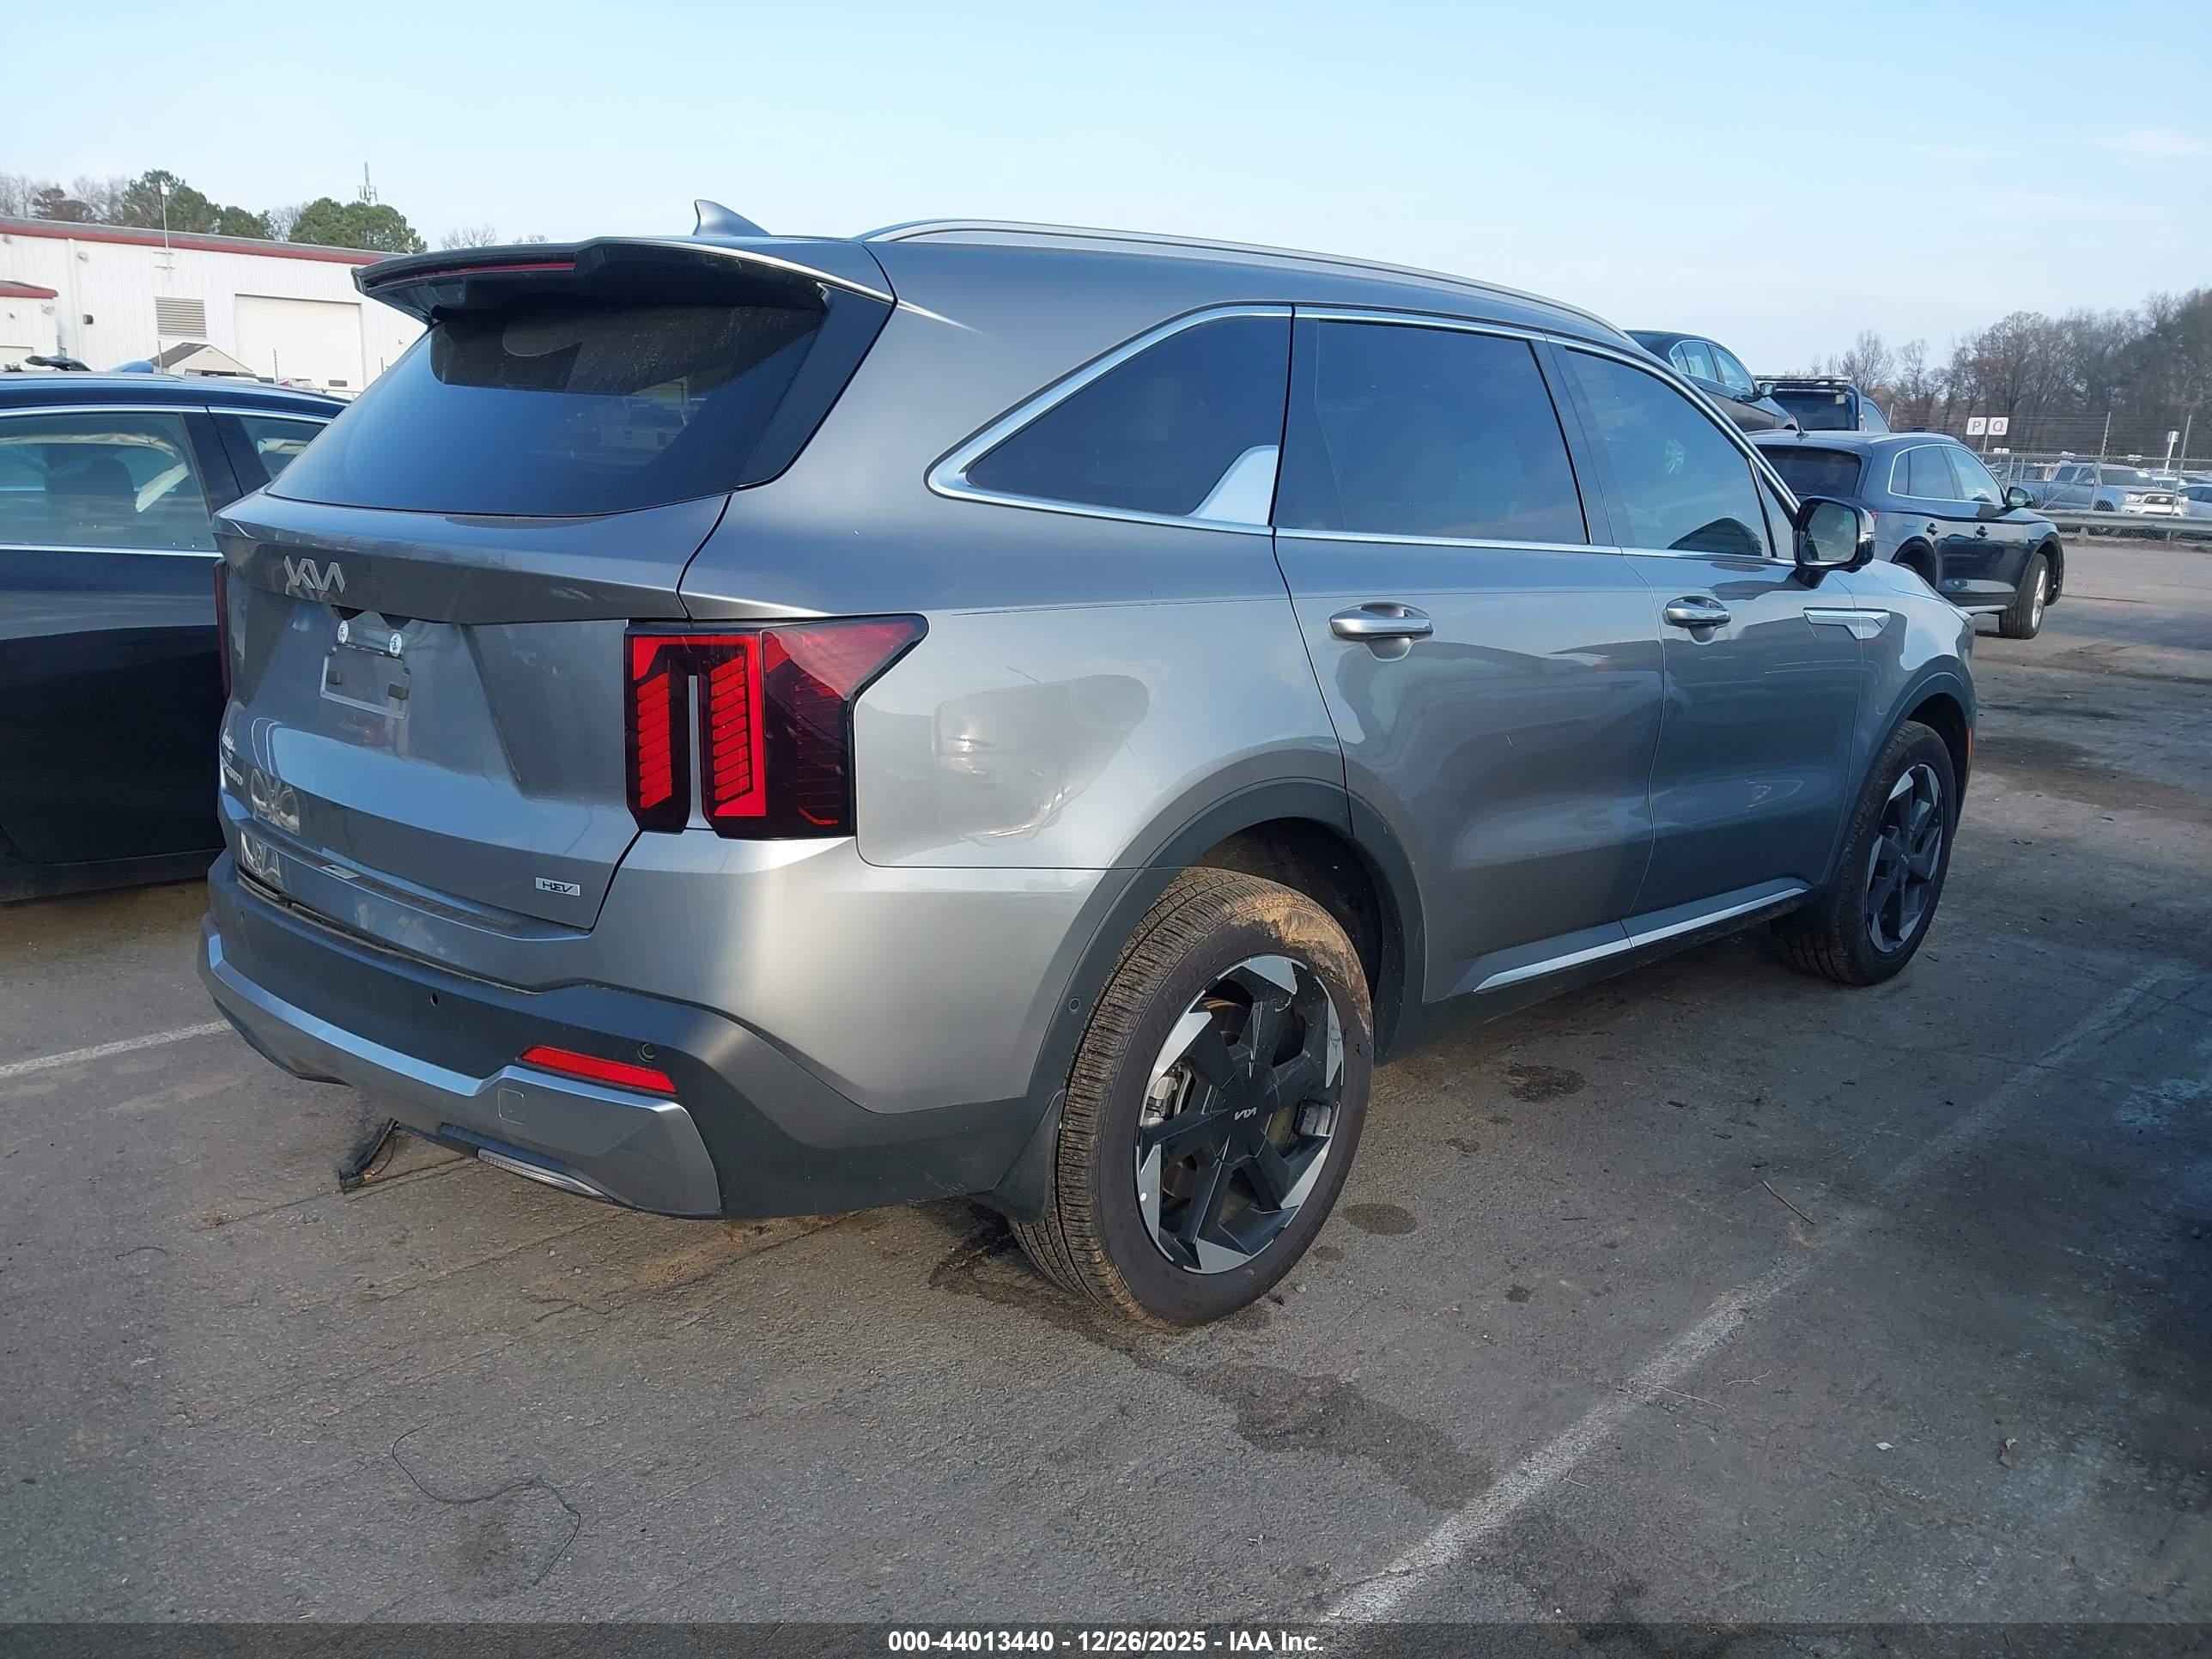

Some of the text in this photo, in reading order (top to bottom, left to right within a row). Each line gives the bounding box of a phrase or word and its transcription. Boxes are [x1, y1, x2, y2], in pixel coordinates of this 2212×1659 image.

[1972, 421, 1982, 432] P
[1993, 420, 2004, 432] Q
[543, 881, 574, 892] HEV
